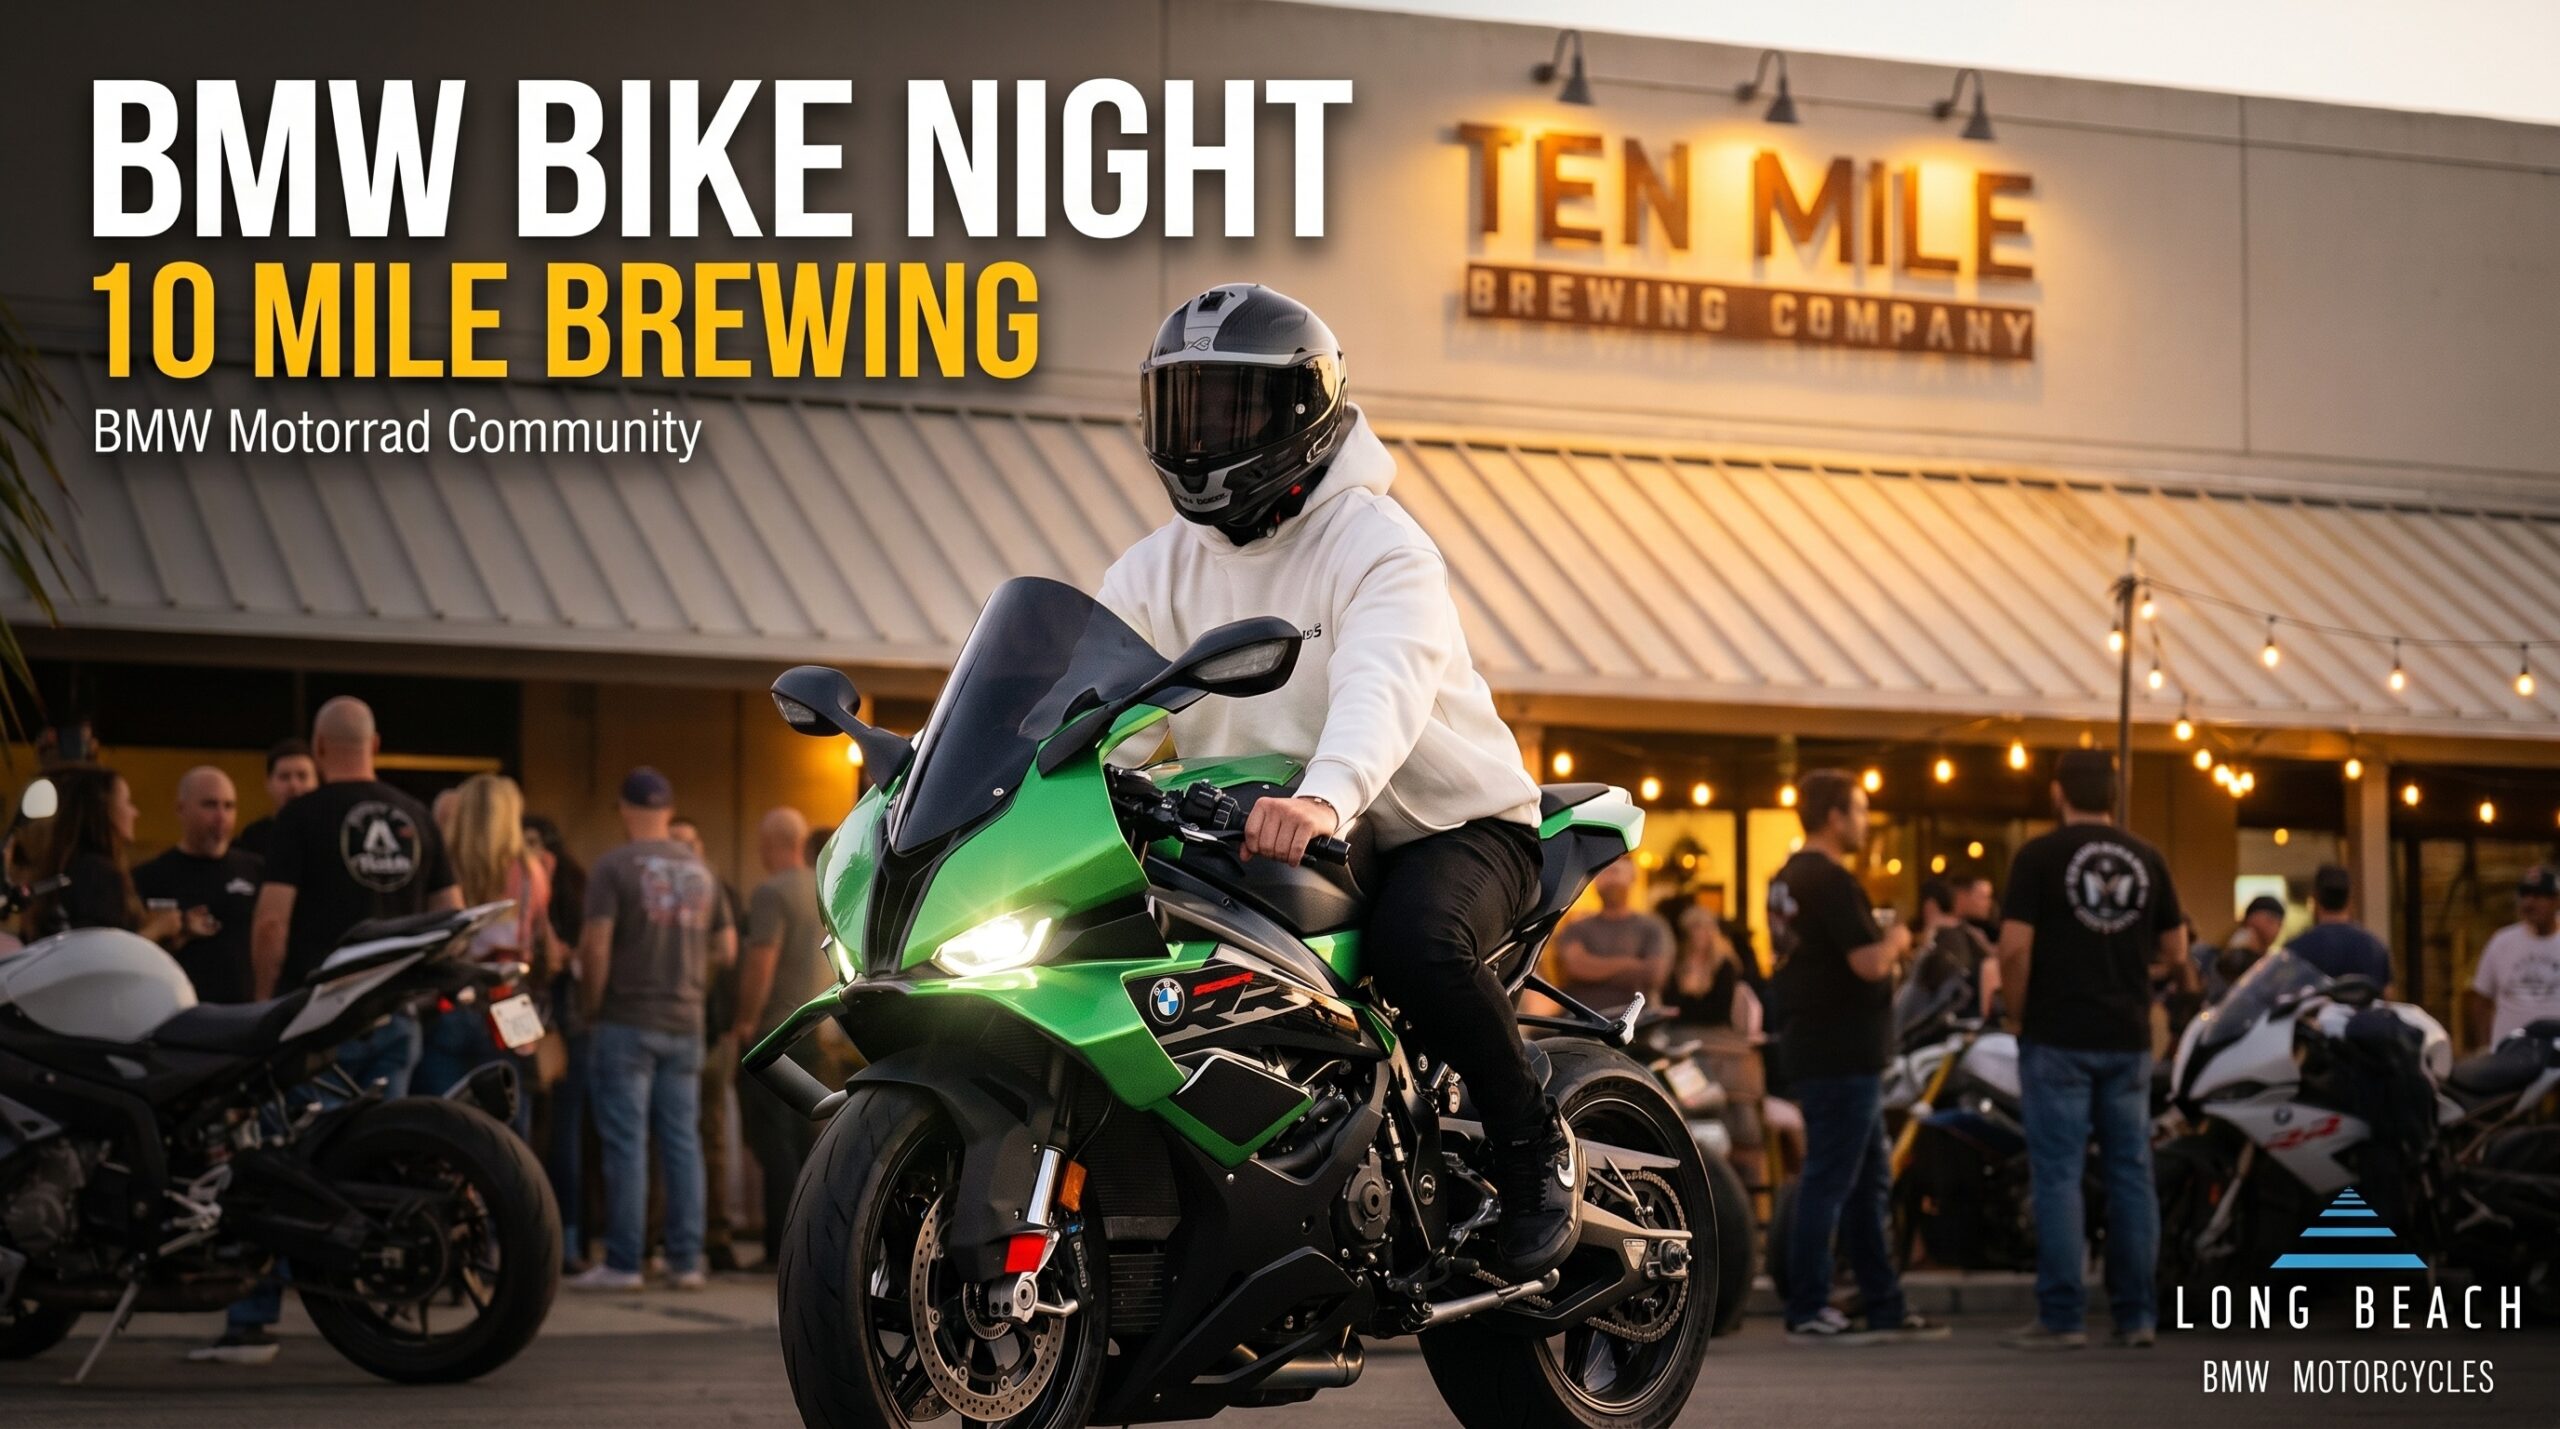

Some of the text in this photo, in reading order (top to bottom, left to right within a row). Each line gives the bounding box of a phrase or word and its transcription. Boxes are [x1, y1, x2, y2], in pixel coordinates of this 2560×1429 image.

[1458, 122, 2034, 279] TEN MILE
[1468, 267, 2033, 355] BREWING COMPANY
